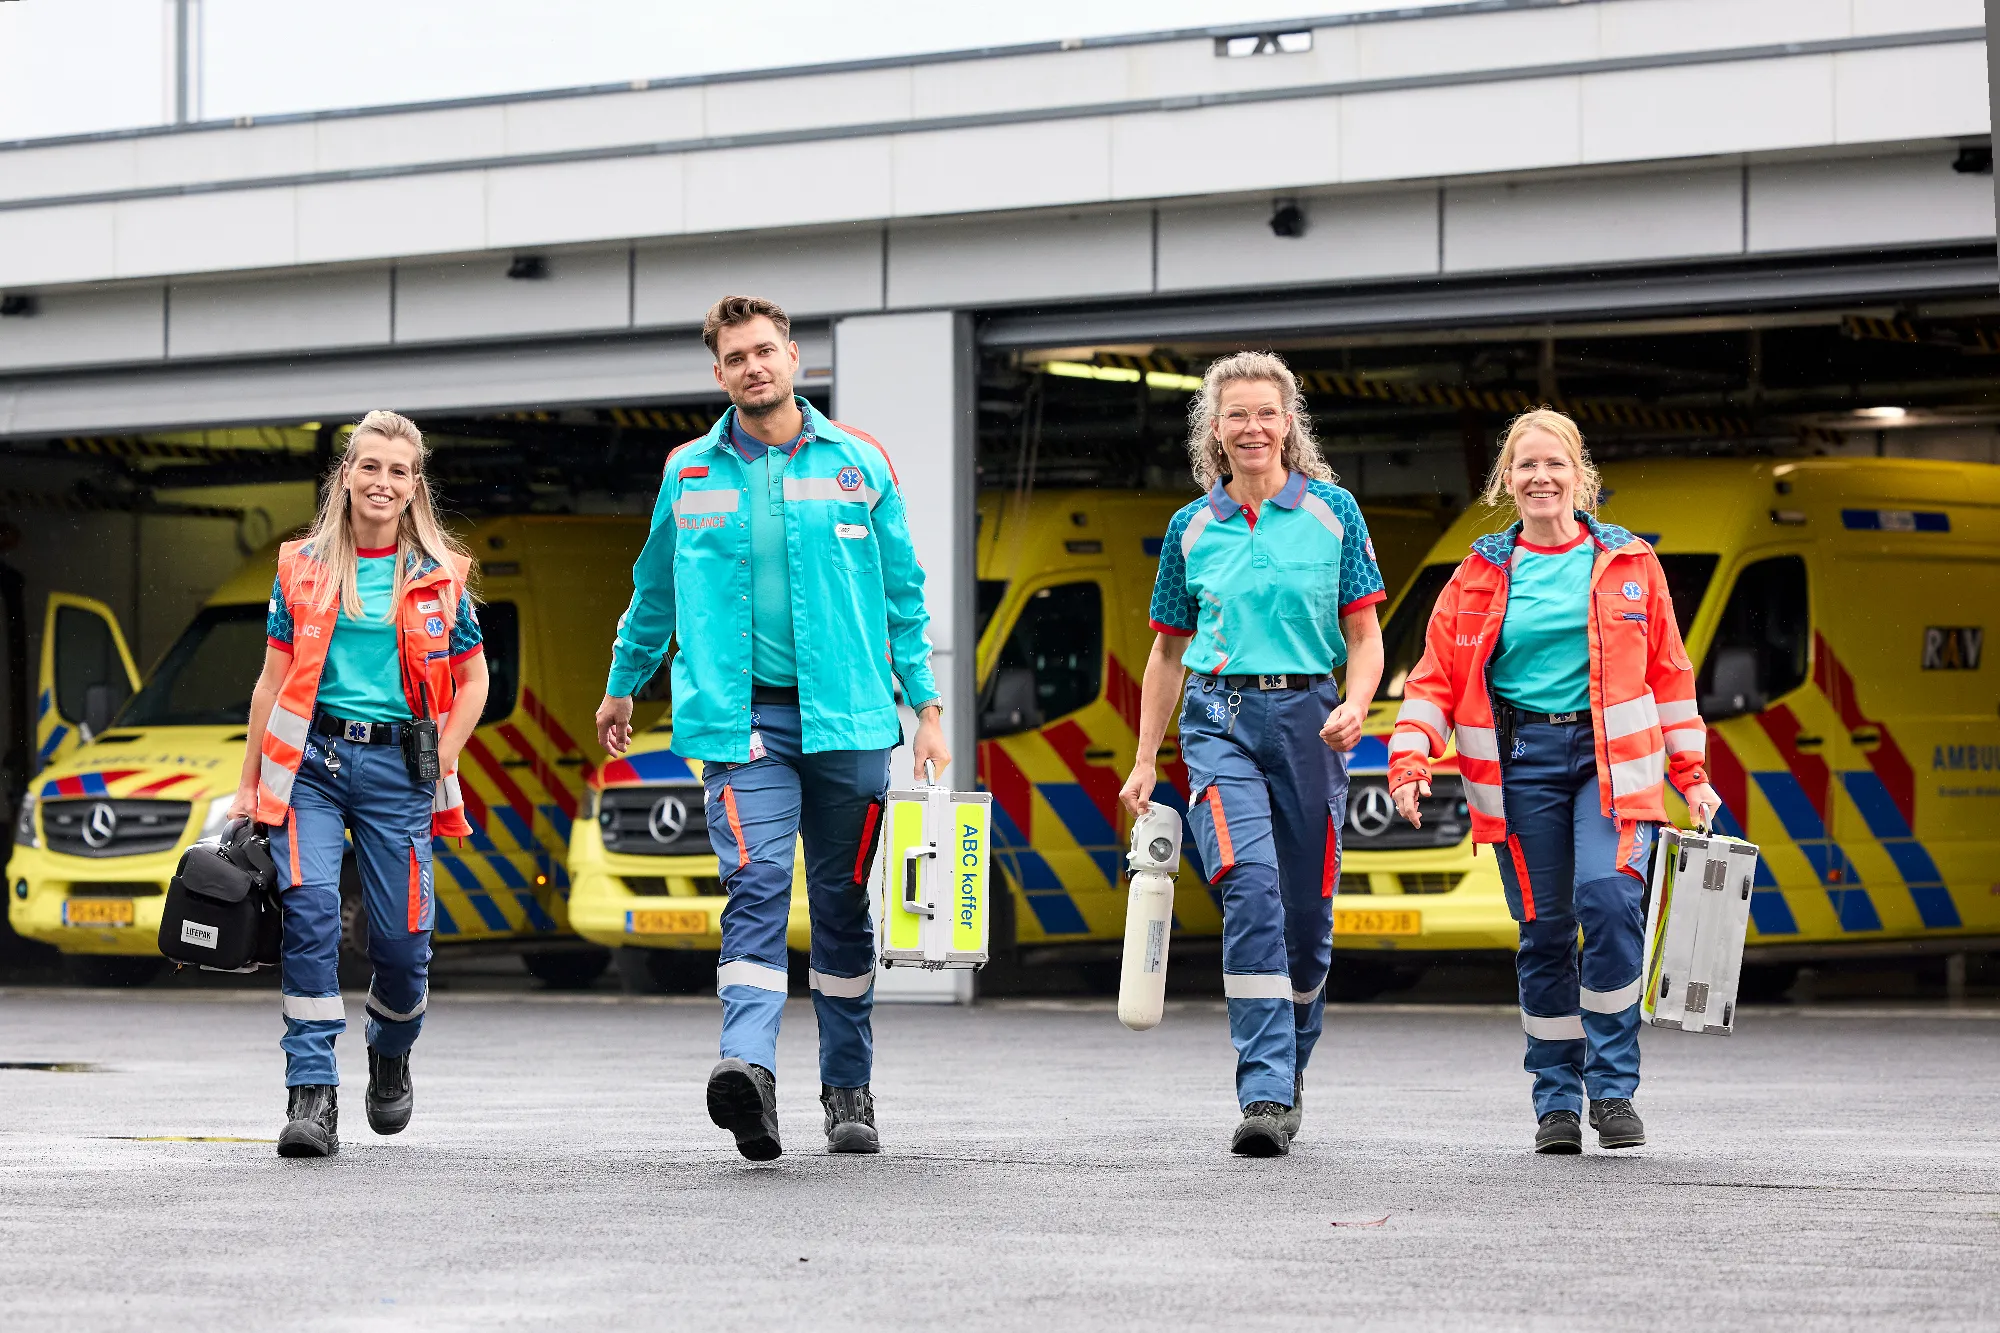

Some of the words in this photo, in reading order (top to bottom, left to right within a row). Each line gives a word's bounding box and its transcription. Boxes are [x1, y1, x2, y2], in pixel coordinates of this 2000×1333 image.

[1923, 628, 1983, 669] RAV
[963, 824, 979, 867] ABC
[961, 873, 977, 930] koffer
[186, 926, 212, 940] LIFEPAK
